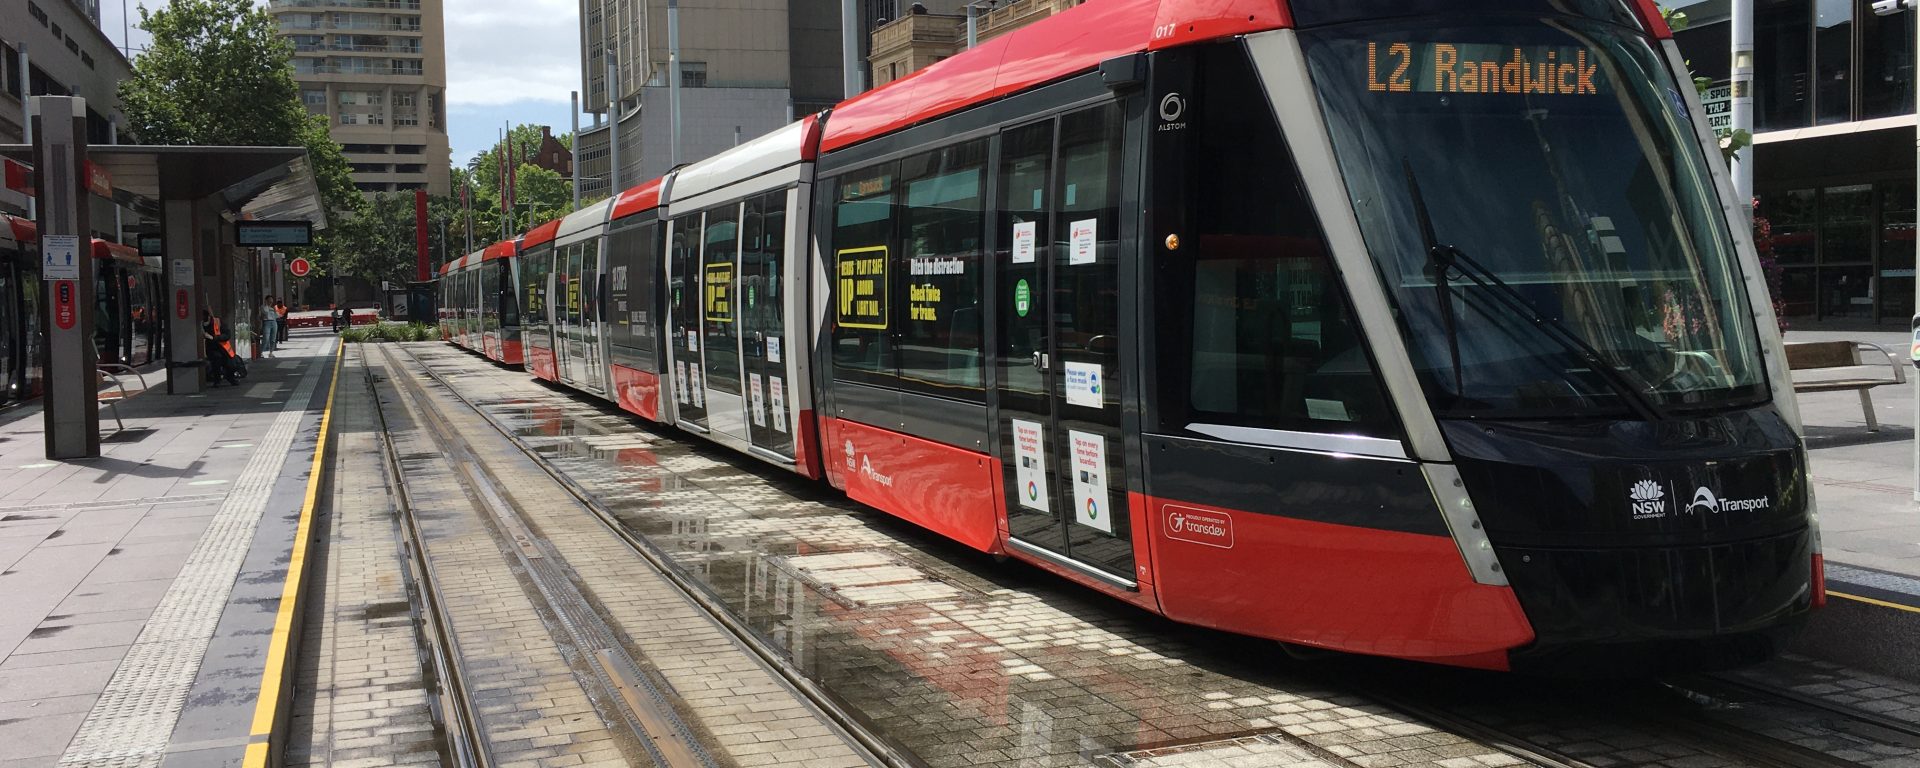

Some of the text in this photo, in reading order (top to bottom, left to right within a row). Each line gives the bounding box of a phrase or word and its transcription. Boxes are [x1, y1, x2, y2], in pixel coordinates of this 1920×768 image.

[1156, 23, 1176, 38] 017
[1368, 42, 1598, 94] L2 Randwick
[1710, 88, 1731, 99] SPOR
[1708, 103, 1725, 114] TAP
[1158, 122, 1186, 131] ALSTOM
[1709, 115, 1731, 127] ARIT
[296, 261, 304, 272] L
[857, 259, 867, 275] PLAY
[872, 258, 883, 275] SAFE
[911, 257, 964, 275] Ditch the distraction
[857, 280, 873, 295] AROUND
[911, 284, 940, 302] Check twice
[841, 278, 854, 316] UP
[857, 300, 879, 316] LIGHT RAIL
[911, 302, 937, 321] for trams.
[1085, 449, 1098, 458] before
[1087, 442, 1099, 450] every
[1079, 458, 1097, 468] boarding
[871, 468, 893, 487] Transport
[1632, 501, 1665, 514] NSW
[1718, 495, 1769, 512] Transport
[1202, 516, 1220, 524] OPERATED
[1186, 520, 1226, 537] transdev
